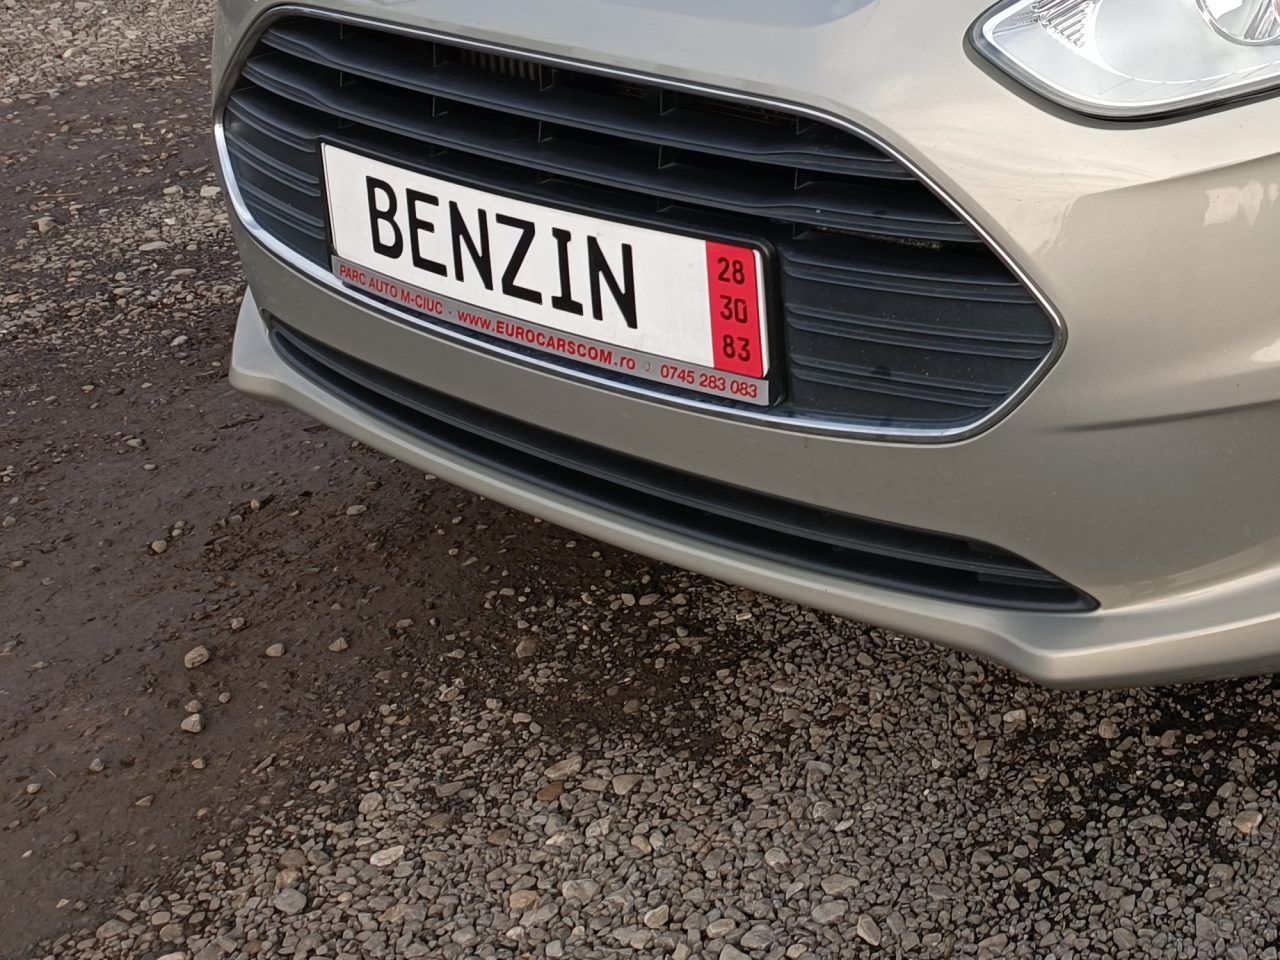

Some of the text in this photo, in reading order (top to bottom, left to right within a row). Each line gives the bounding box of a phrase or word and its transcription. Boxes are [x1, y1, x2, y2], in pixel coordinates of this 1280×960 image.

[365, 175, 638, 329] BENZIN
[717, 257, 745, 285] 28
[719, 295, 748, 324] 30
[340, 264, 367, 285] PARC
[368, 277, 398, 298] AUTO
[400, 289, 443, 315] M-CIUC
[660, 364, 695, 384] 0745
[699, 373, 726, 391] 283
[730, 380, 758, 399] 083
[721, 334, 751, 363] 83
